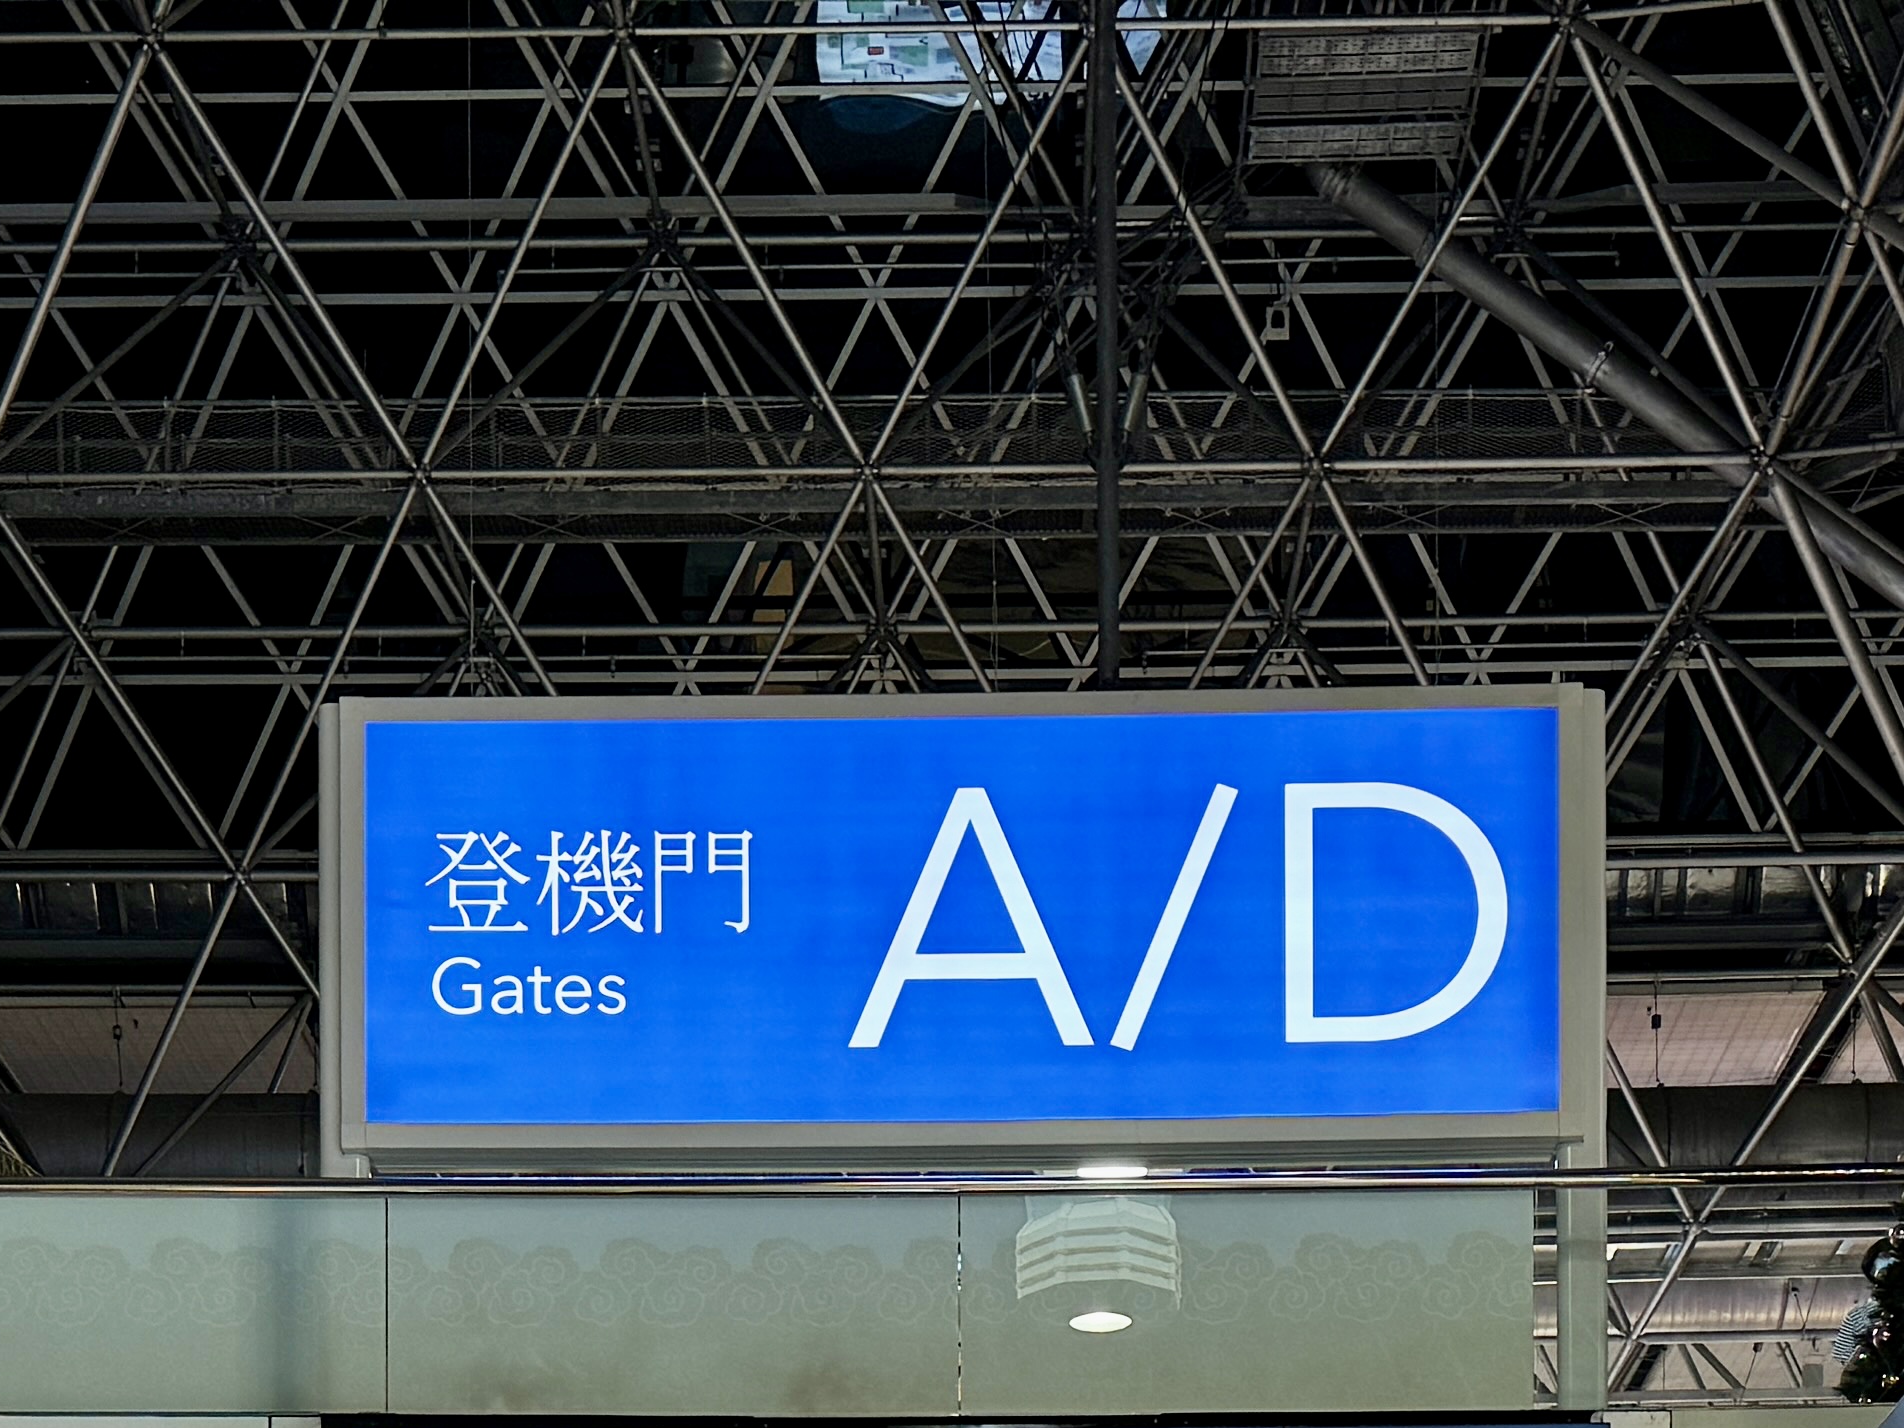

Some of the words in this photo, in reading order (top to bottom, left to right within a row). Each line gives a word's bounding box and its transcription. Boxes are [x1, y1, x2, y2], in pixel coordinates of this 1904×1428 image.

[424, 827, 755, 938] 登機門
[848, 780, 1510, 1054] A/D
[431, 955, 628, 1017] Gates
